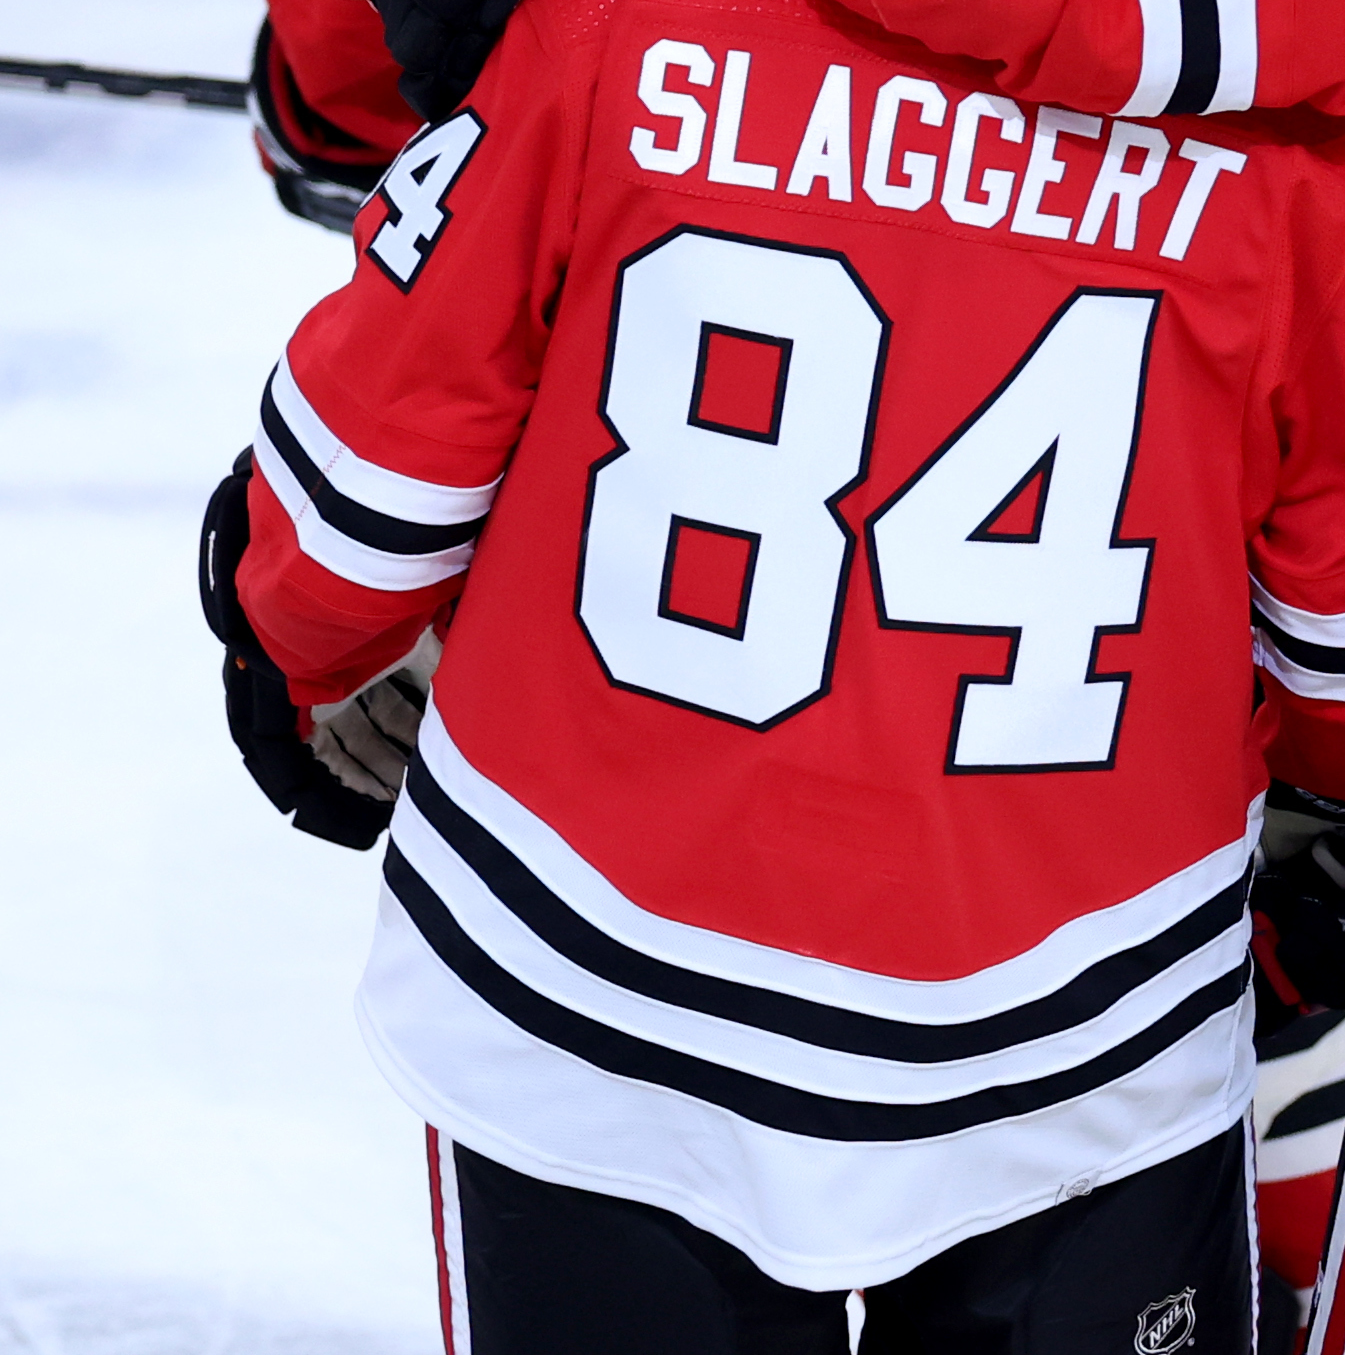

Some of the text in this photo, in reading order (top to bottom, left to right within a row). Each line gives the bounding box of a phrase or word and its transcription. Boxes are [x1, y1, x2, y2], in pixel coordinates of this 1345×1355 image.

[629, 38, 1248, 262] SLAGGERT
[572, 222, 1165, 776] 84
[1149, 1304, 1185, 1349] NHL
